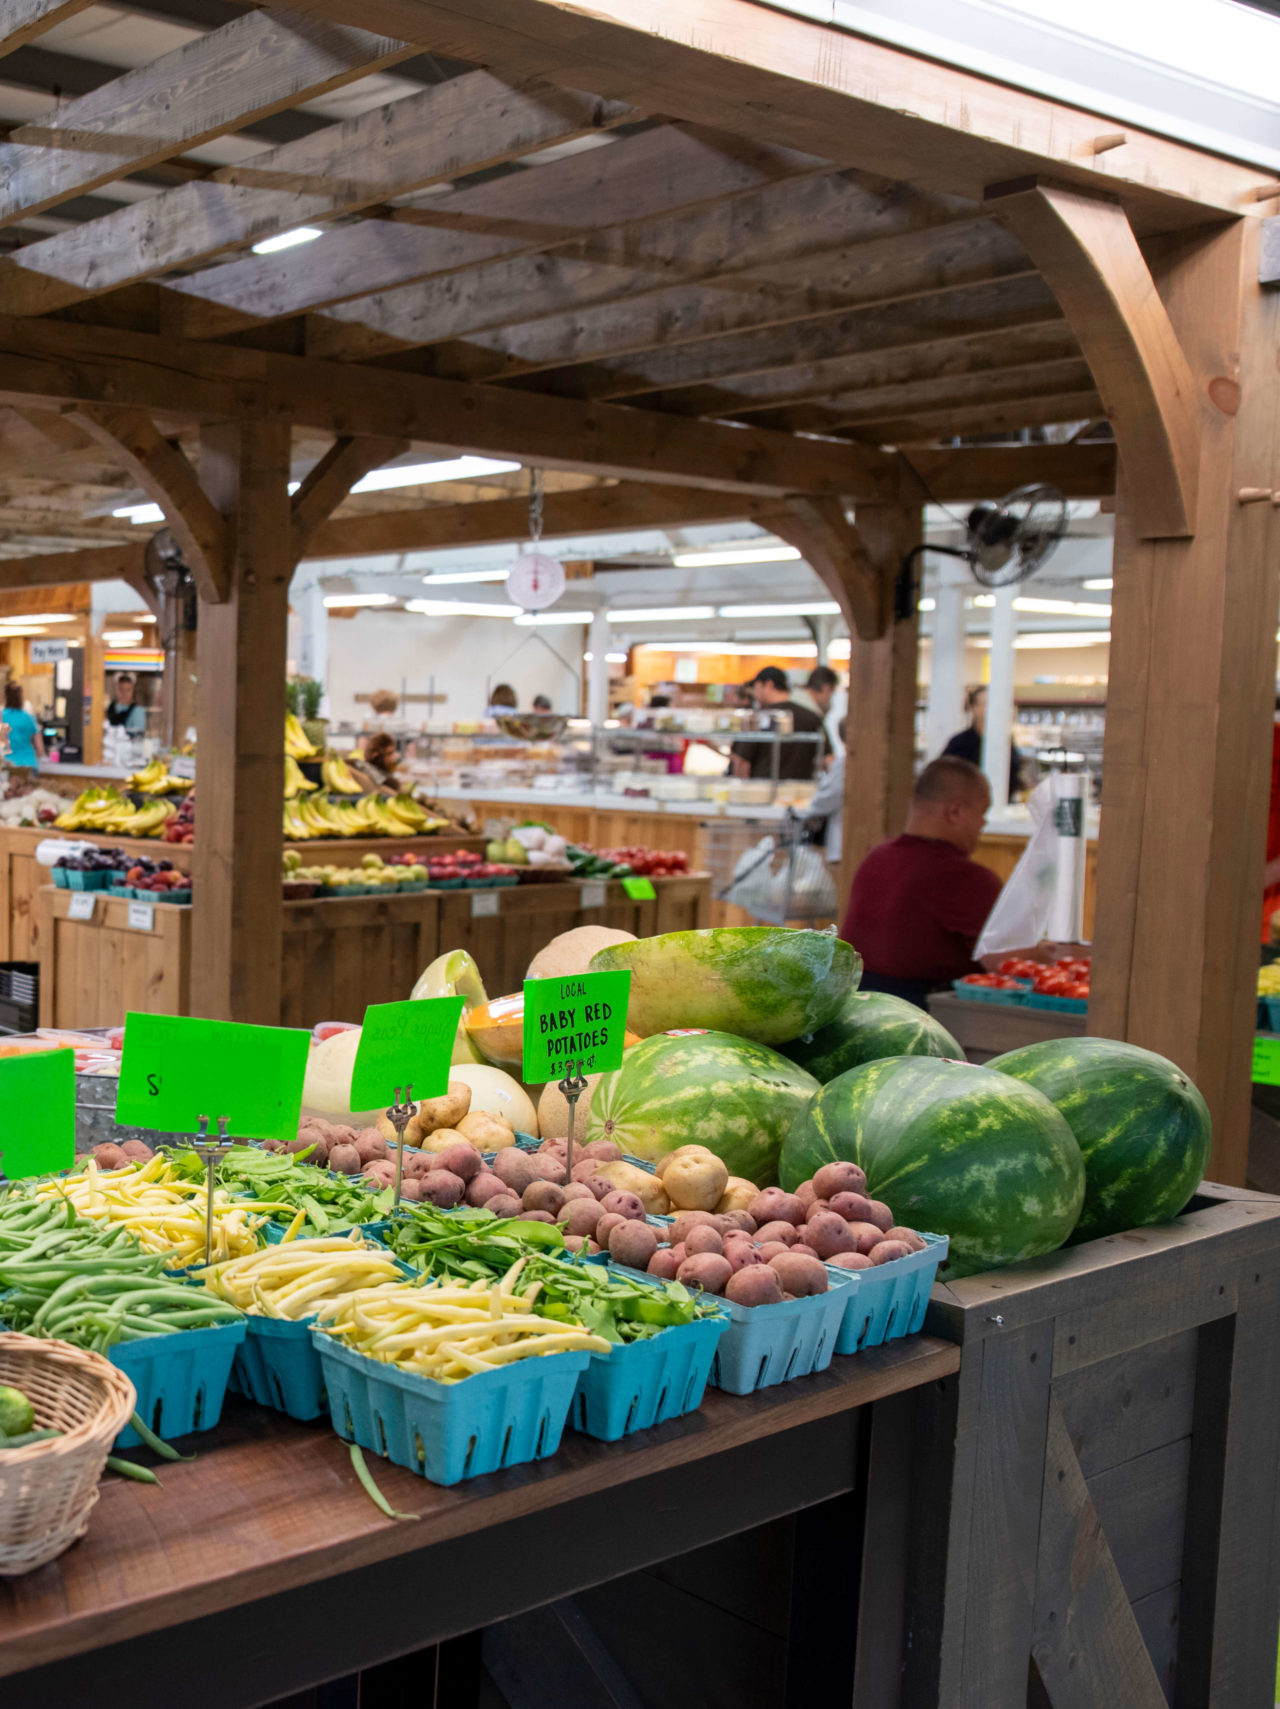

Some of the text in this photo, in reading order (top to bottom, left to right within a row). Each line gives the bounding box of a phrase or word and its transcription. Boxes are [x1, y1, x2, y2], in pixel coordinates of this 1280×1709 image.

[560, 981, 587, 1000] LOCAL
[540, 1002, 612, 1034] BABY RED
[547, 1027, 608, 1057] POTATOES
